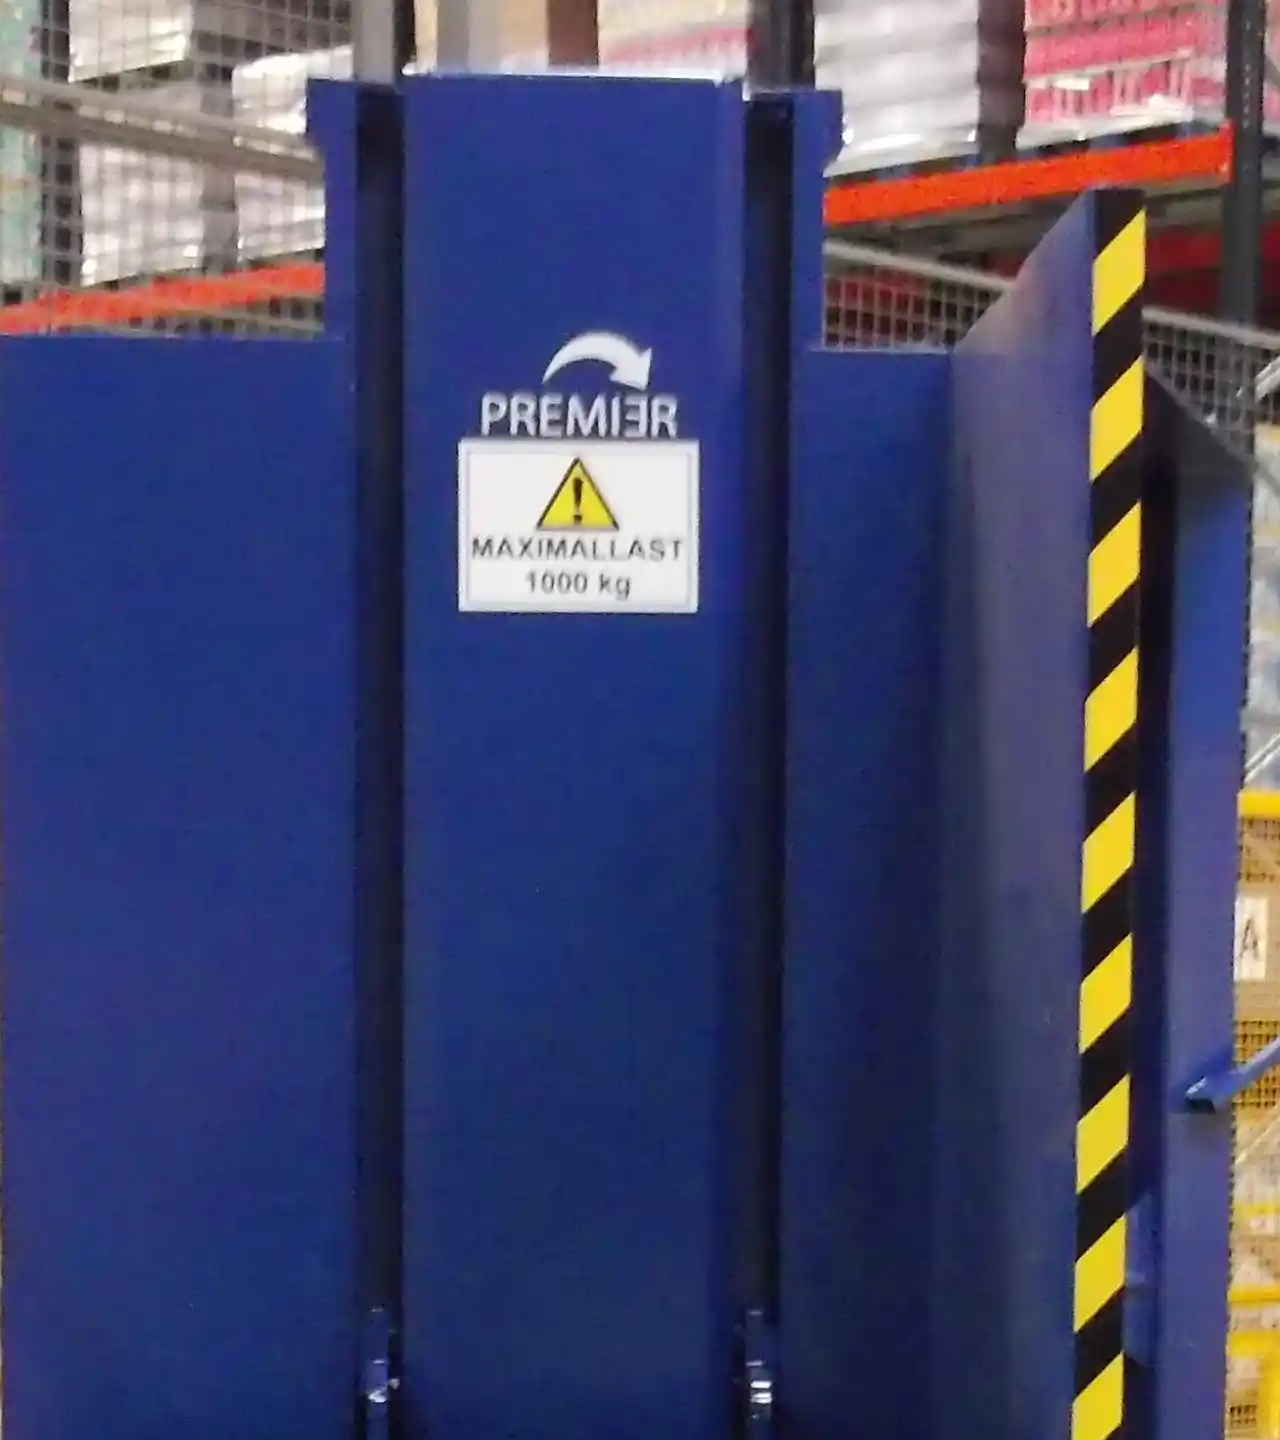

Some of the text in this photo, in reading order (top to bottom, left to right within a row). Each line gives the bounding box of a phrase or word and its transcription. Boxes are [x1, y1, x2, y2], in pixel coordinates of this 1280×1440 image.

[480, 391, 678, 438] PREMIER
[471, 536, 684, 563] MAXIMALLAST
[524, 571, 631, 601] 1000 kg
